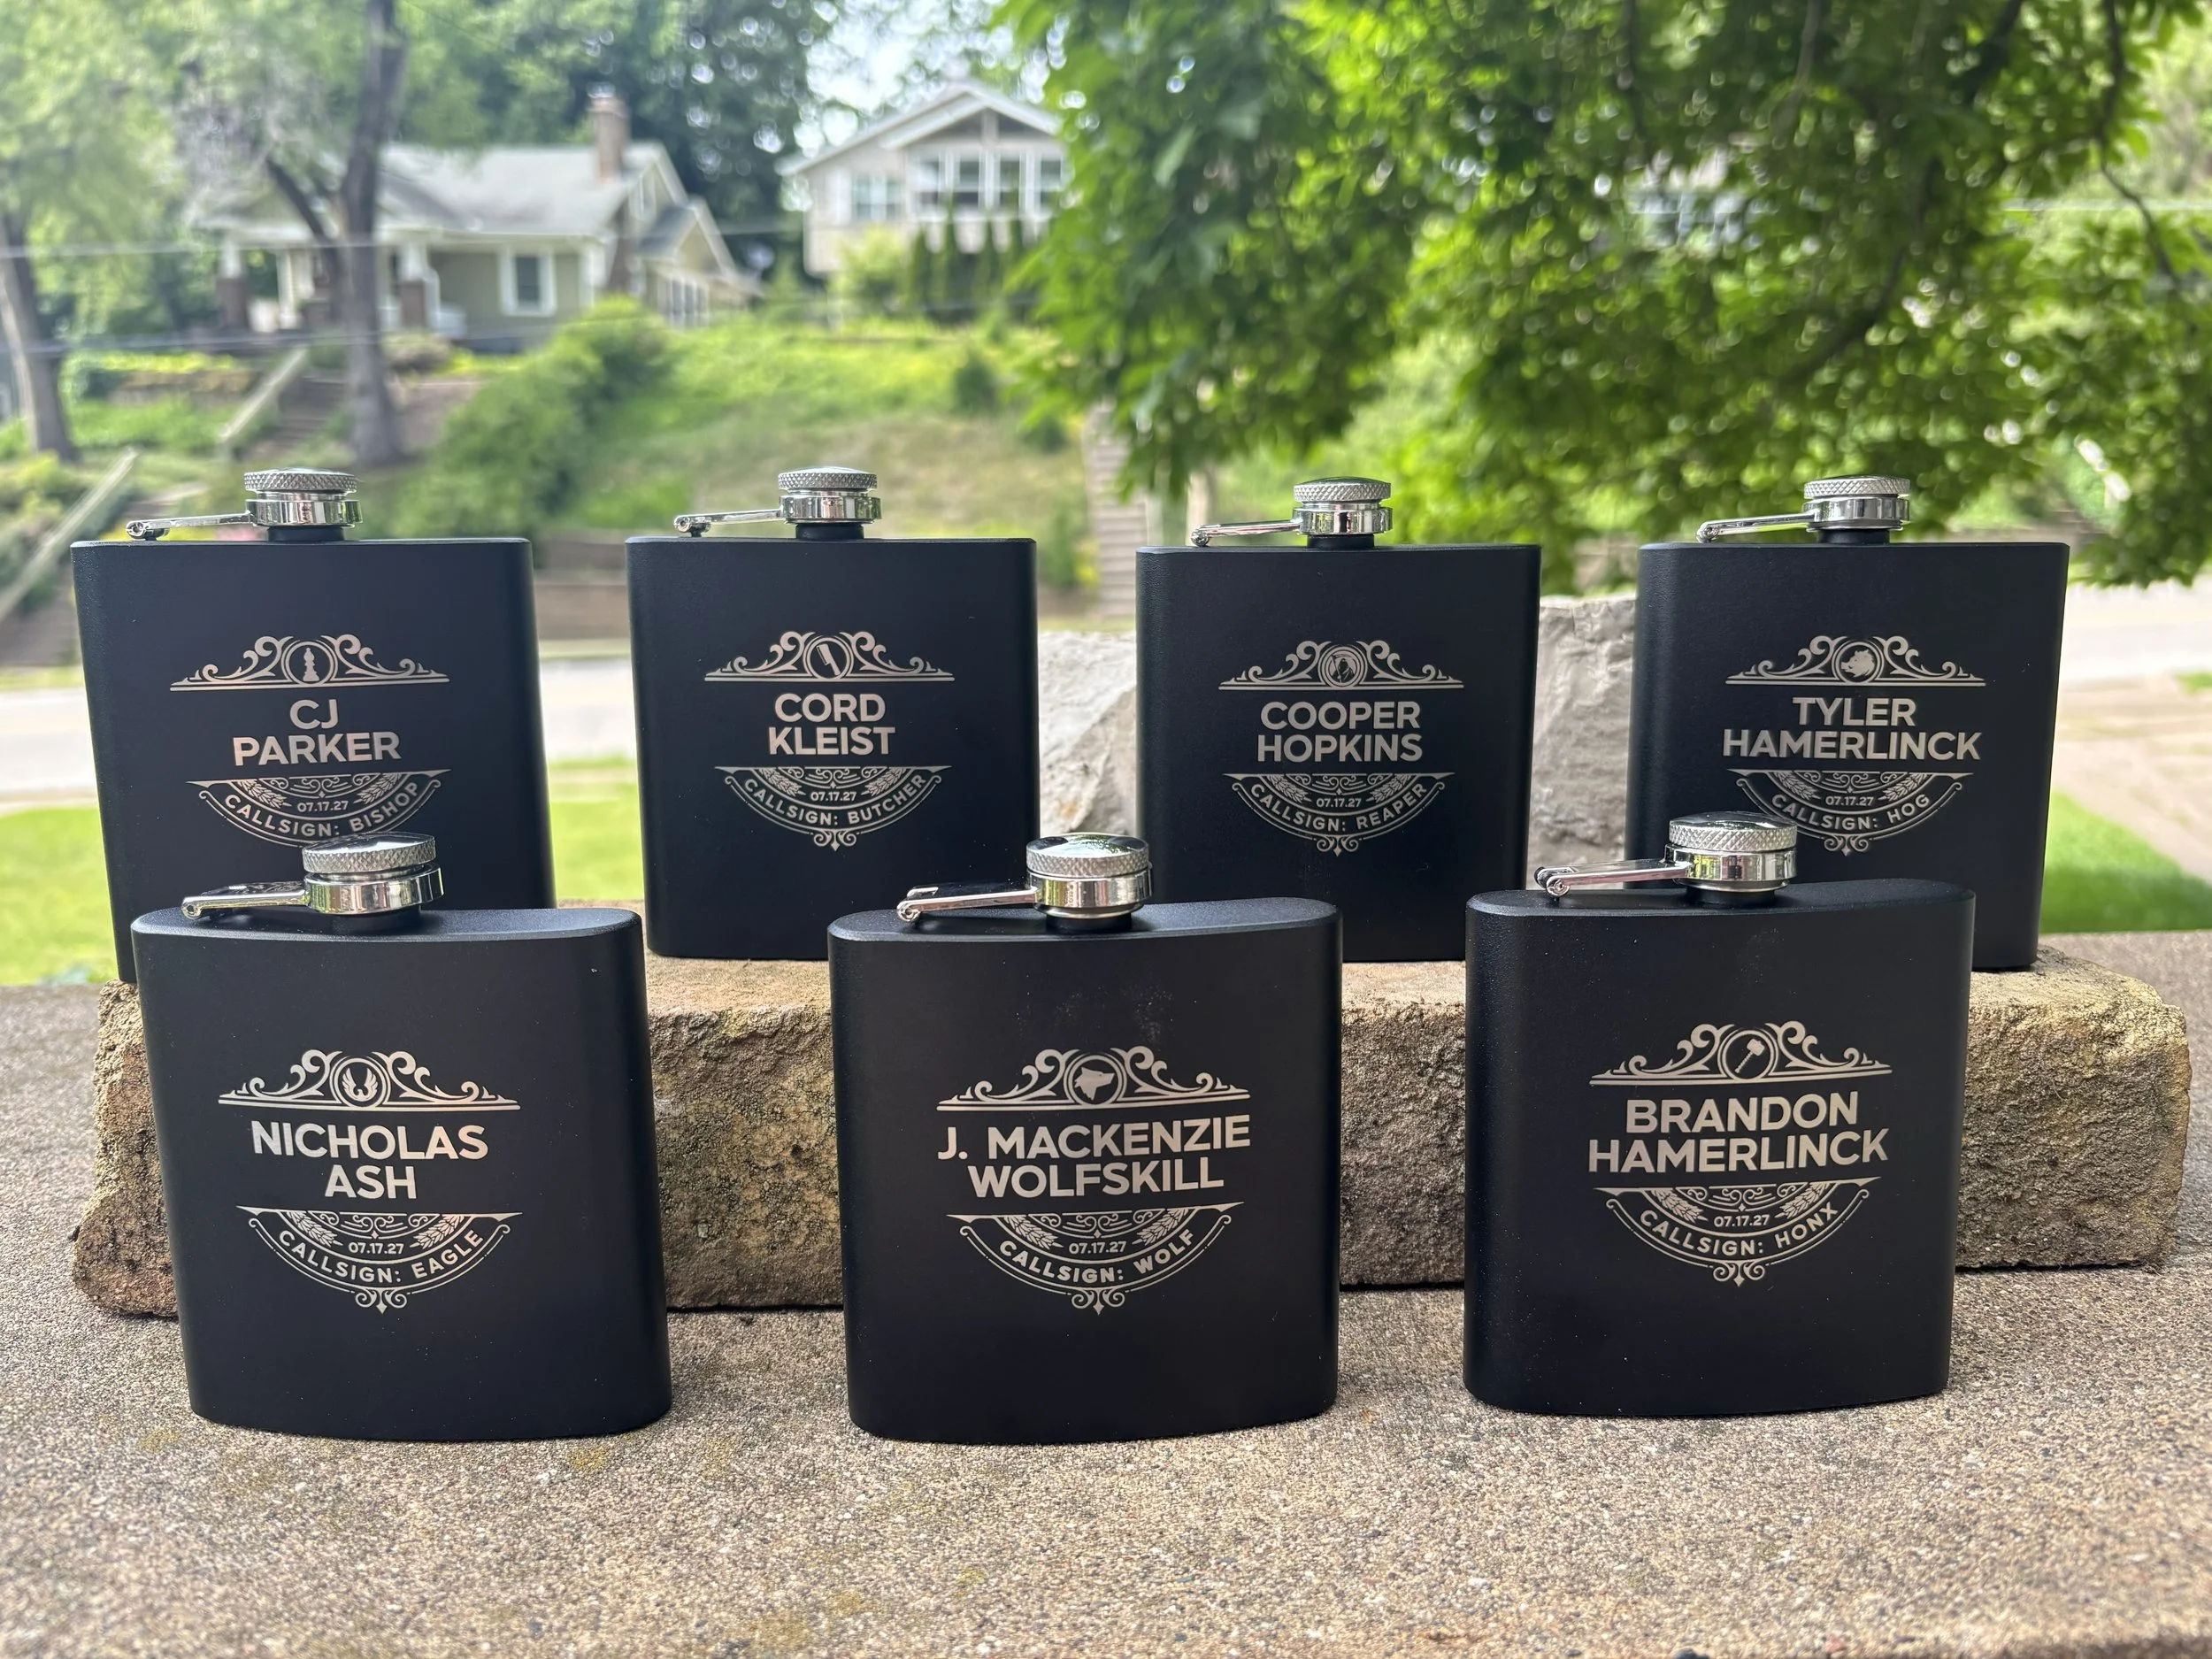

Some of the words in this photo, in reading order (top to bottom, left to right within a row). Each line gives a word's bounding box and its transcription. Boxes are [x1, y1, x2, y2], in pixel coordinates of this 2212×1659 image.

[289, 699, 339, 730] CJ
[774, 693, 886, 722] CORD
[1260, 701, 1421, 730] COOPER
[1793, 697, 1916, 726] TYLER
[233, 731, 402, 766] PARKER
[769, 726, 895, 755] KLEIST
[1257, 733, 1423, 763] HOPKINS
[1723, 729, 1981, 760] HAMERLINCK
[225, 795, 340, 836] CALLSIGN:
[349, 782, 419, 832] BISHOP
[296, 800, 349, 813] 07.17.27
[744, 779, 838, 826] CALLSIGN:
[848, 774, 926, 825] BUTCHER
[810, 792, 856, 802] 07.17.27
[1251, 784, 1346, 832] CALLSIGN:
[1356, 783, 1427, 830] REAPER
[1316, 798, 1362, 808] 07.17.27
[1772, 795, 1878, 830] CALLSIGN:
[1887, 795, 1930, 823] HOG
[1825, 796, 1874, 806] 07.17.27
[1625, 1091, 1858, 1133] BRANDON
[251, 1120, 488, 1160] NICHOLAS
[937, 1126, 968, 1160] J.
[987, 1114, 1250, 1160] MACKENZIE
[1588, 1128, 1889, 1172] HAMERLINCK
[325, 1164, 417, 1200] ASH
[967, 1156, 1225, 1198] WOLFSKILL
[1640, 1210, 1763, 1256] CALLSIGN:
[1775, 1202, 1839, 1248] HONX
[1714, 1215, 1770, 1227] 07.17.27
[280, 1230, 401, 1283] CALLSIGN:
[411, 1230, 483, 1279] EAGLE
[349, 1242, 404, 1255] 07.17.27
[1000, 1240, 1124, 1283] CALLSIGN:
[1133, 1229, 1194, 1274] WOLF
[1069, 1241, 1126, 1255] 07.17.27
